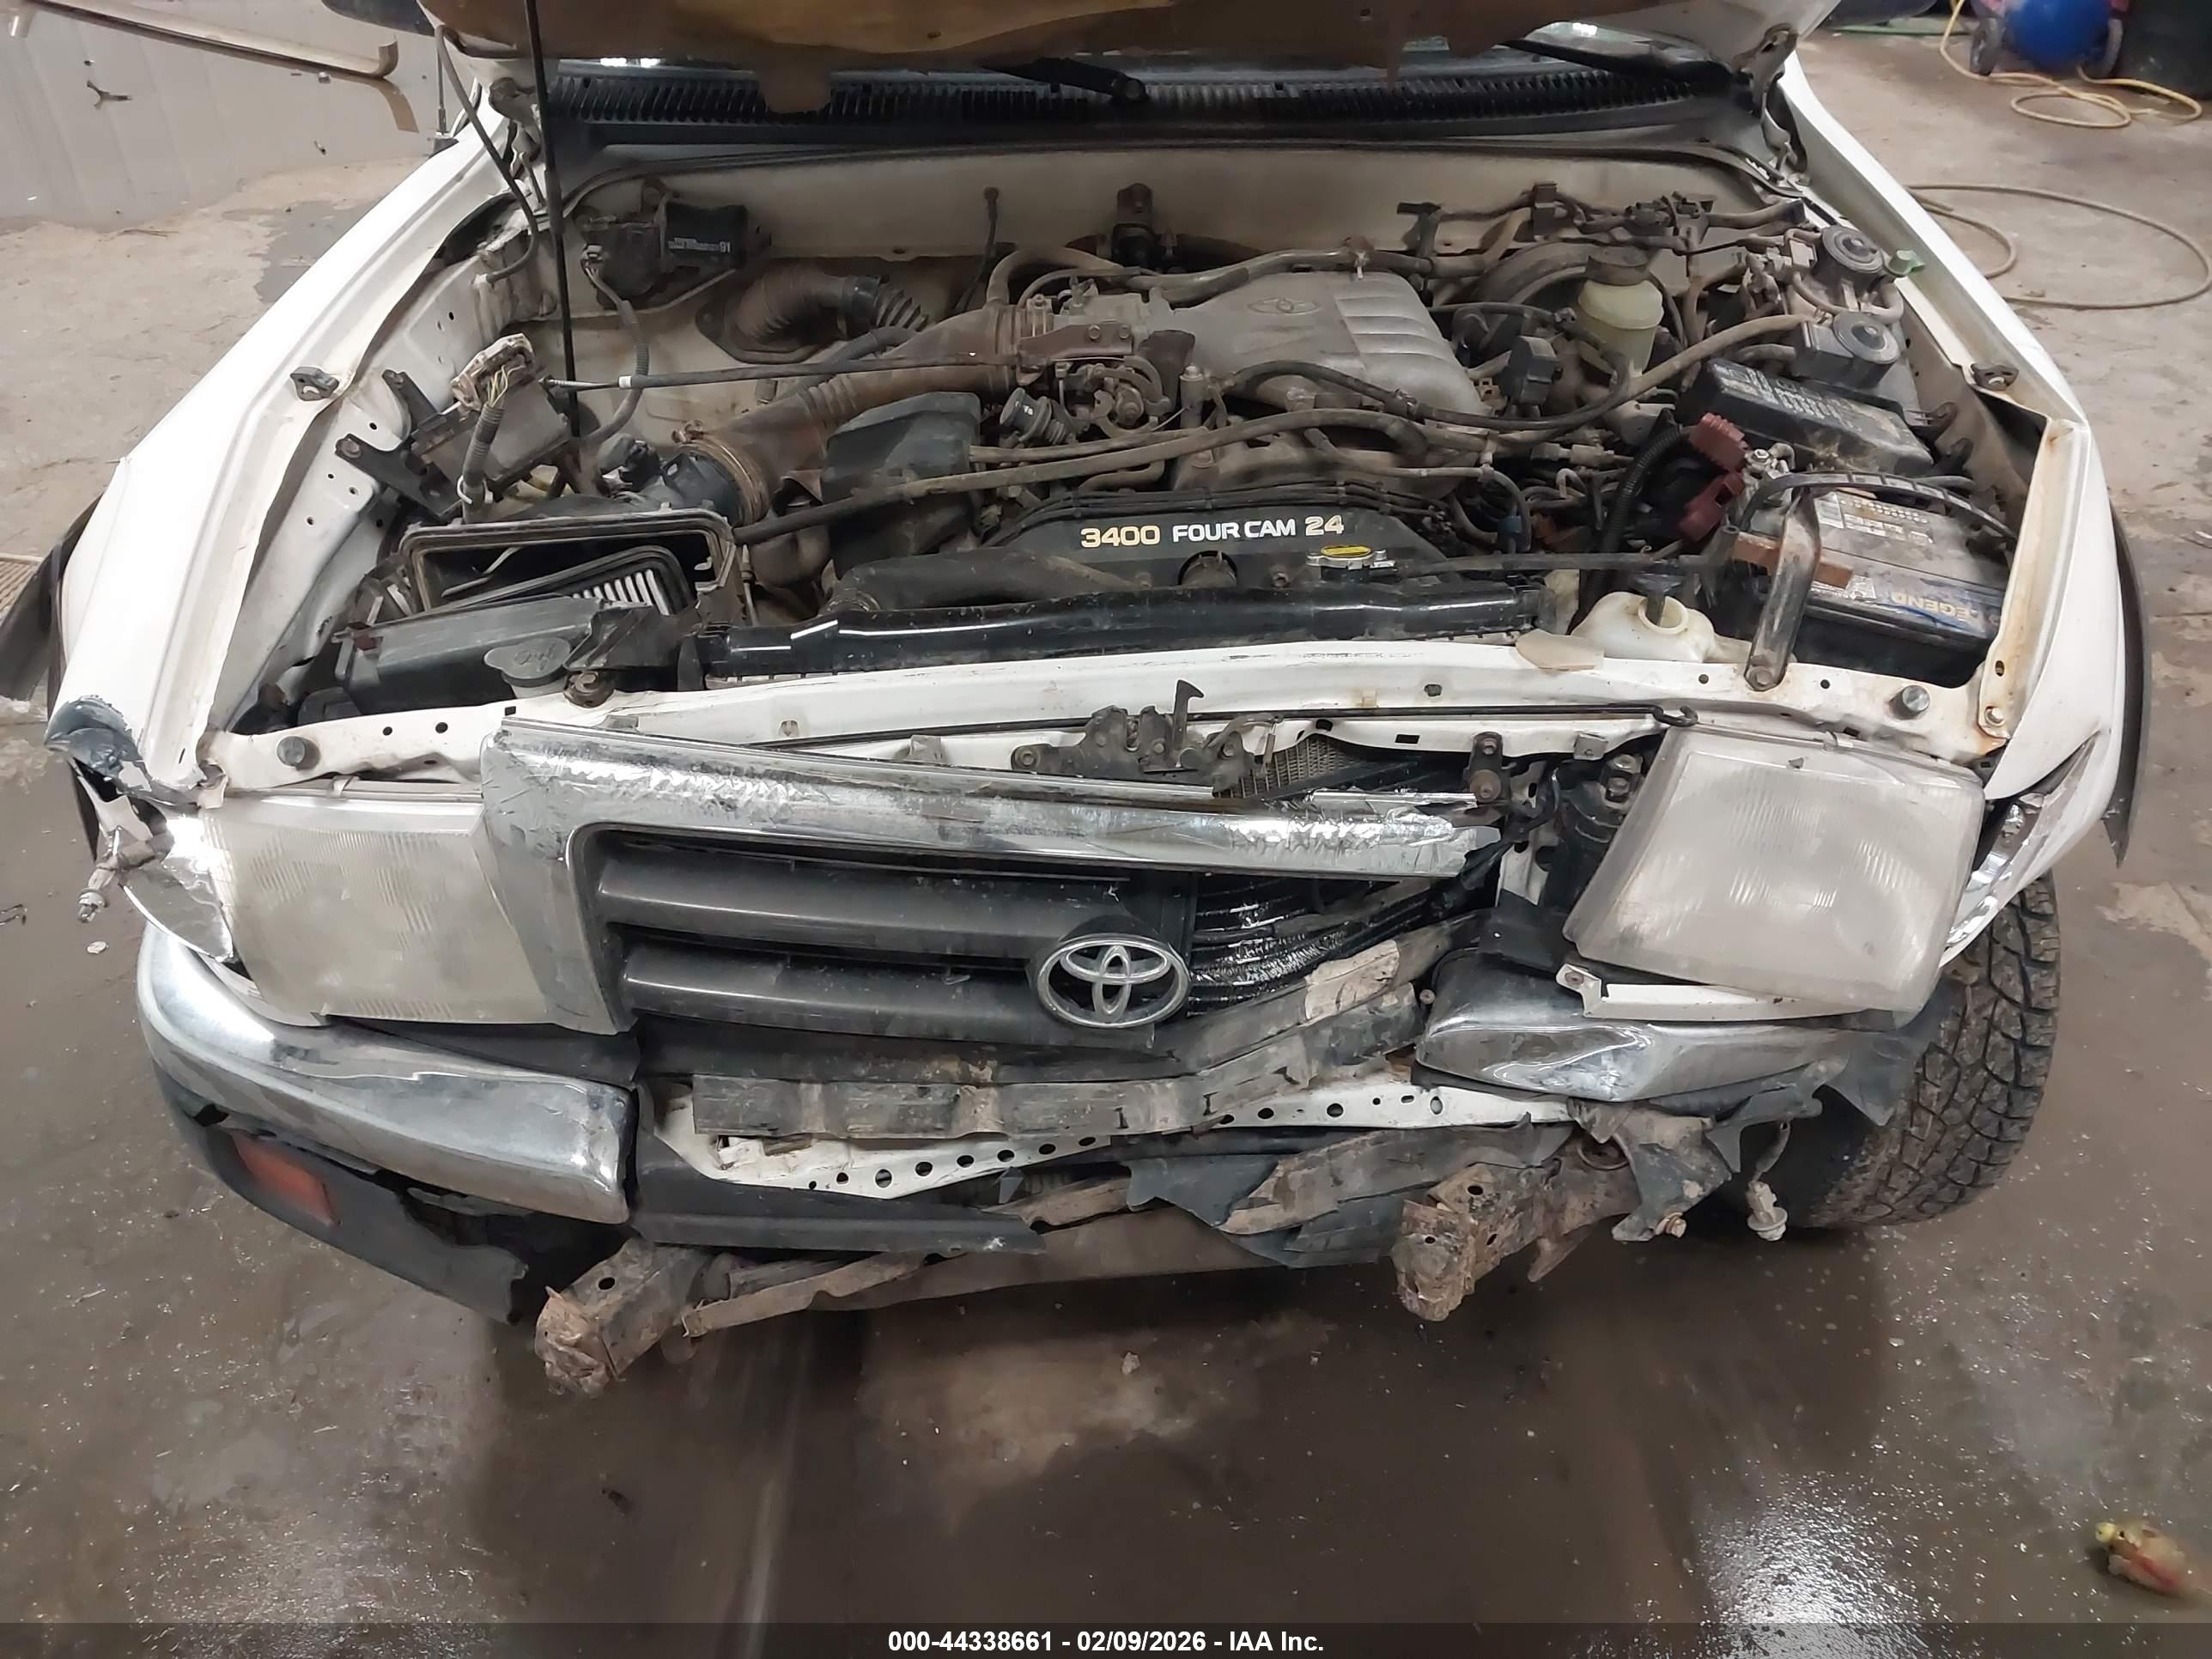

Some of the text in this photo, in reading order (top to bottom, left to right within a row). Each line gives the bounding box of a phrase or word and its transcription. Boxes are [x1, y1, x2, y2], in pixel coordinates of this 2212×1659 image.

[1080, 514, 1345, 548] 3400 FOUR CAM 24
